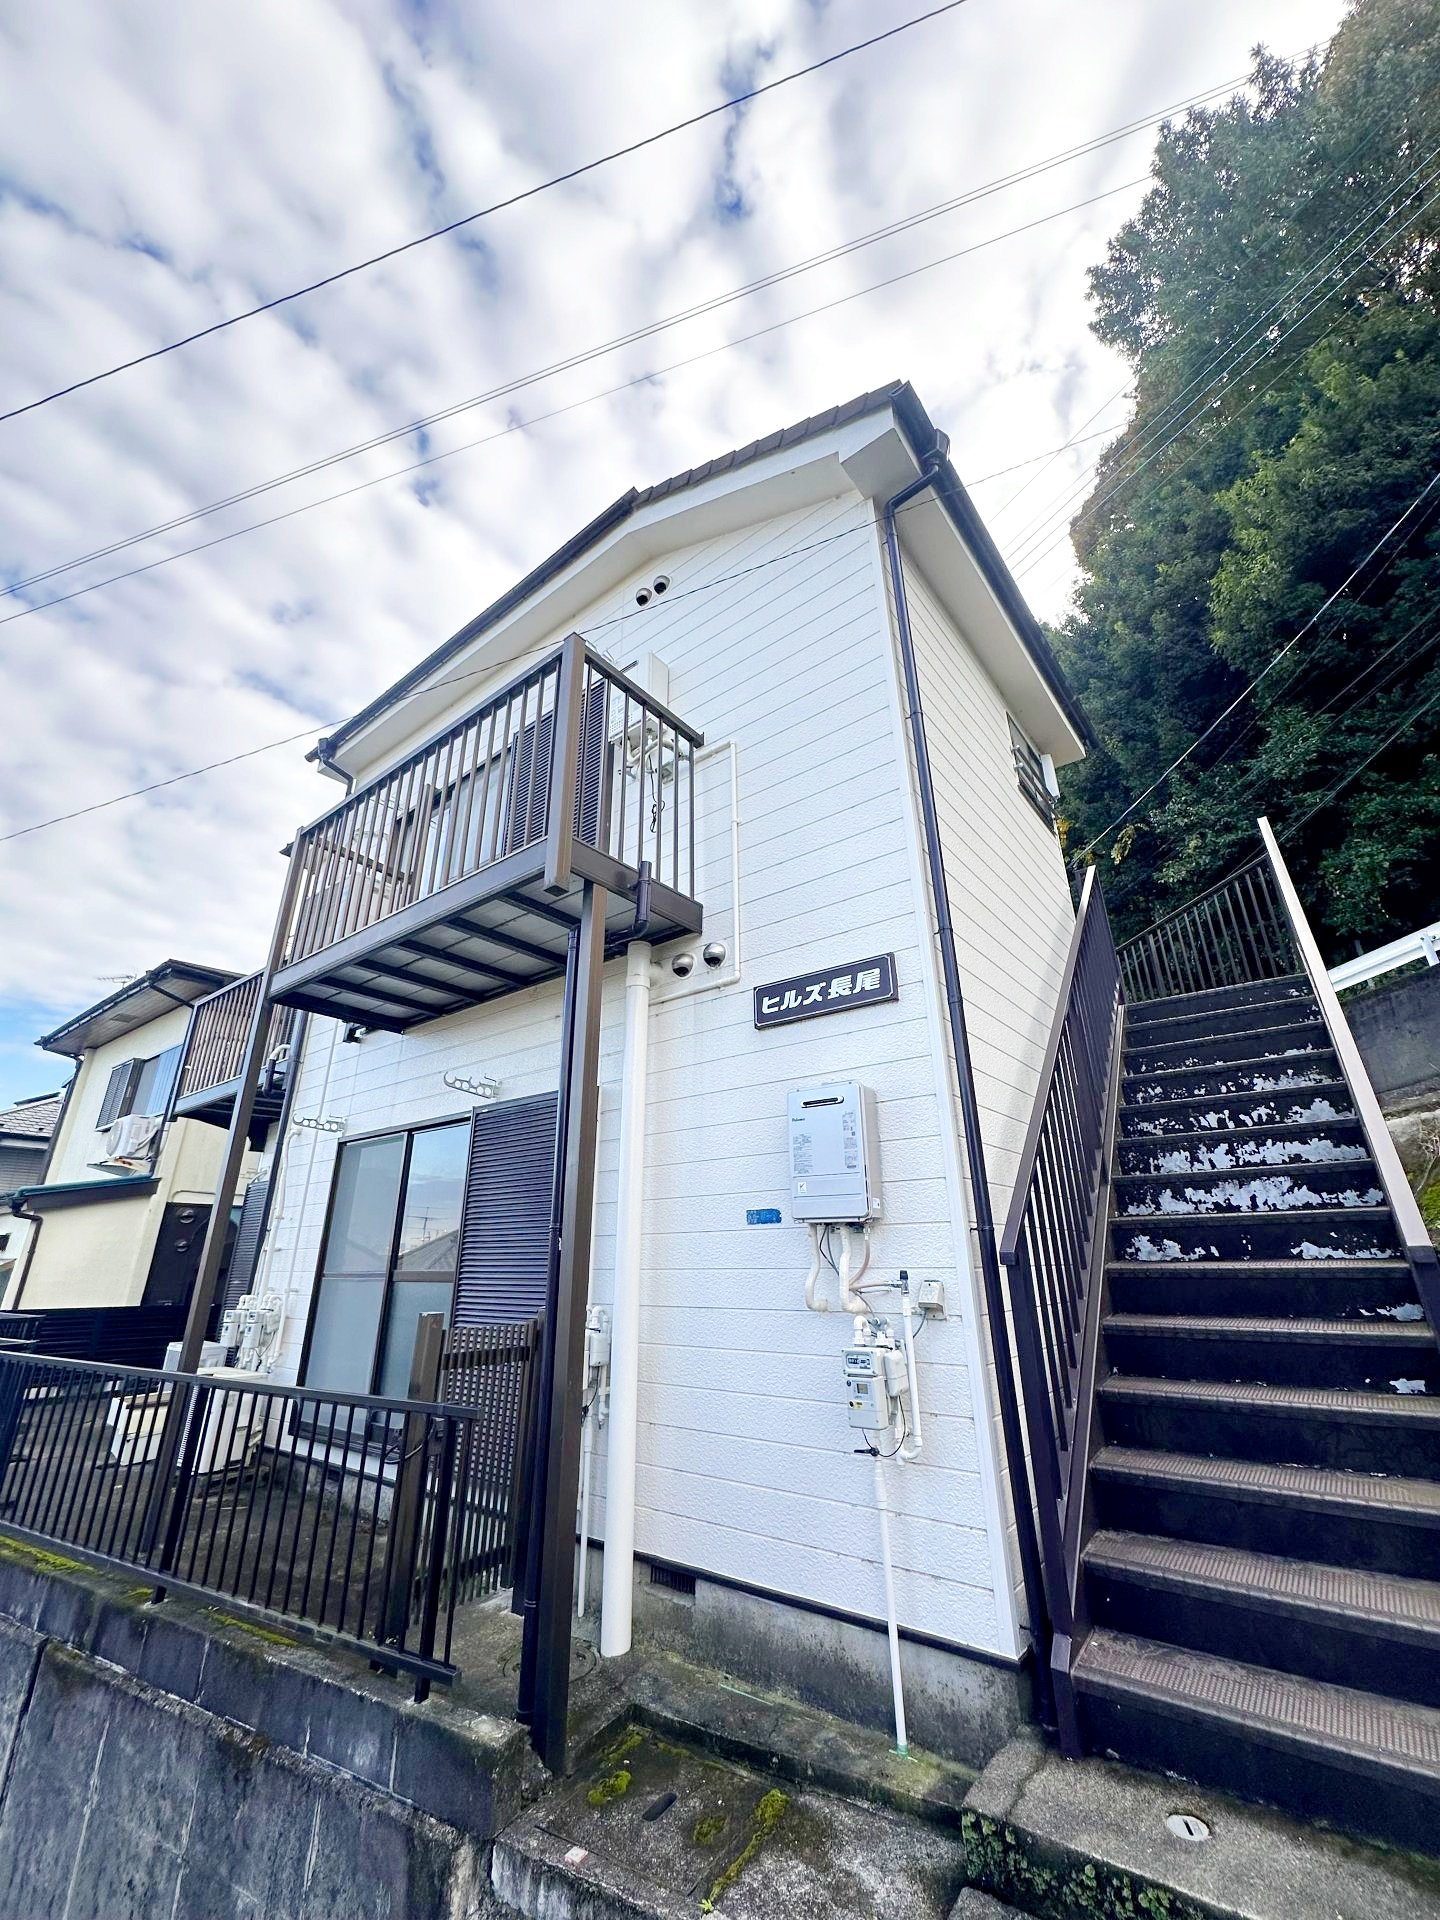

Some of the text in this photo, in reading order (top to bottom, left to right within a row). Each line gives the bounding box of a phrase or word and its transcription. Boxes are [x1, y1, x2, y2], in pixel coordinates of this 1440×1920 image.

[761, 967, 881, 1014] ヒルズ長尾
